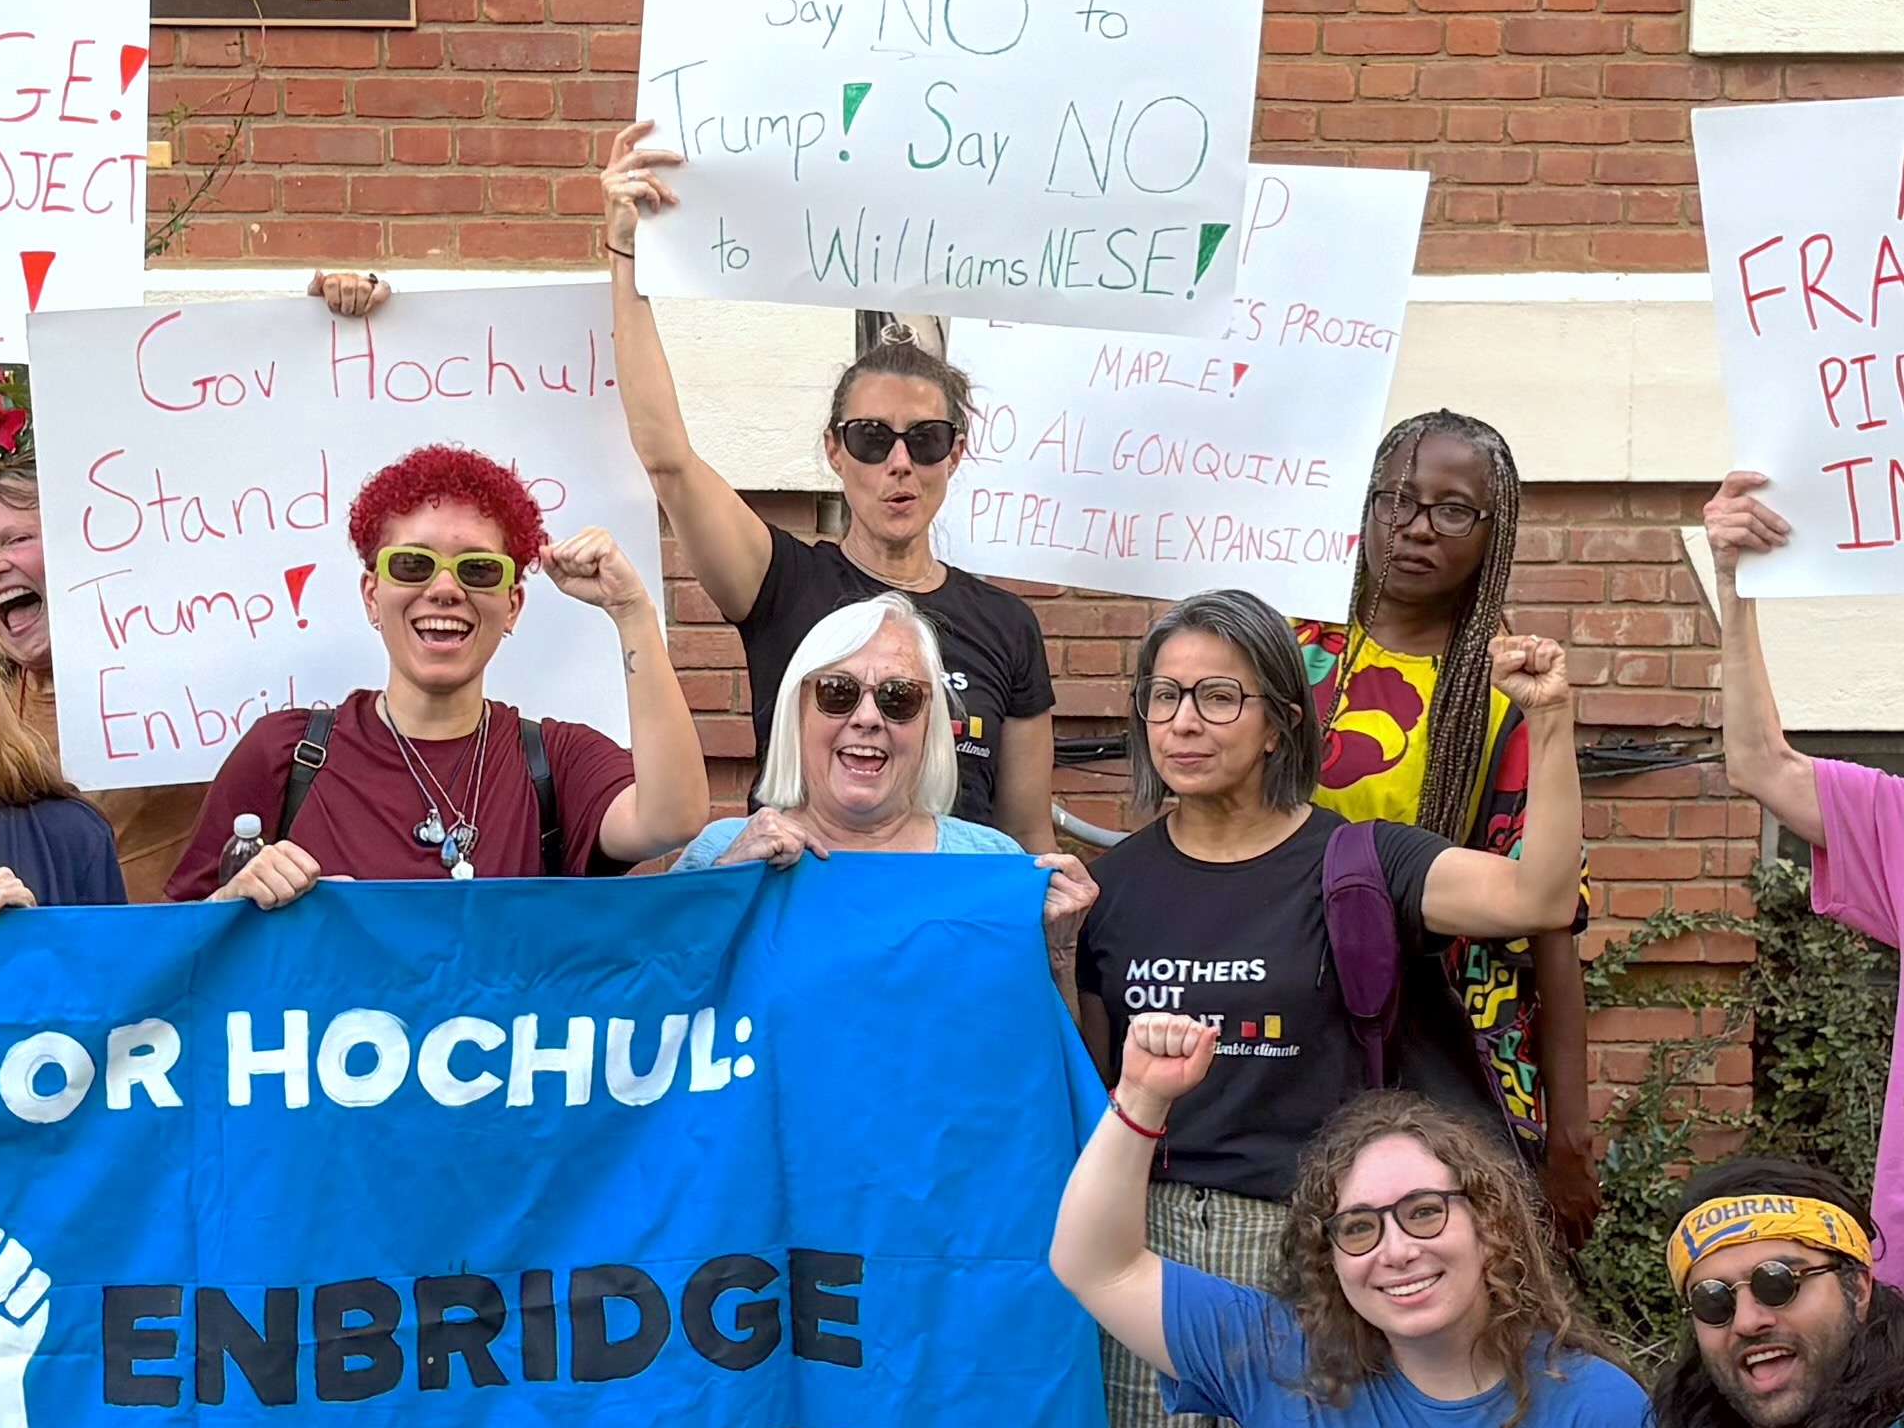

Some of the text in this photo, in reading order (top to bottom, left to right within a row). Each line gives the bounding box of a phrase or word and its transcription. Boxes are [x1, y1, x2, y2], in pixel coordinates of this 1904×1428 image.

[649, 60, 1208, 196] Trump! Say NO
[712, 217, 750, 274] to
[136, 310, 275, 412] Gov
[1279, 302, 1400, 353] PROJECT
[1088, 345, 1249, 398] MAPLE!
[82, 448, 329, 552] Stand
[970, 488, 1360, 565] PIPELINE EXPANSION!
[68, 563, 317, 650] Trump!
[1124, 985, 1185, 1009] OUT
[1126, 958, 1267, 983] MOTHERS
[227, 1007, 756, 1109] HOCHUL:
[1693, 1197, 1796, 1233] ZOHRAN
[102, 1248, 864, 1406] ENBRIDGE
